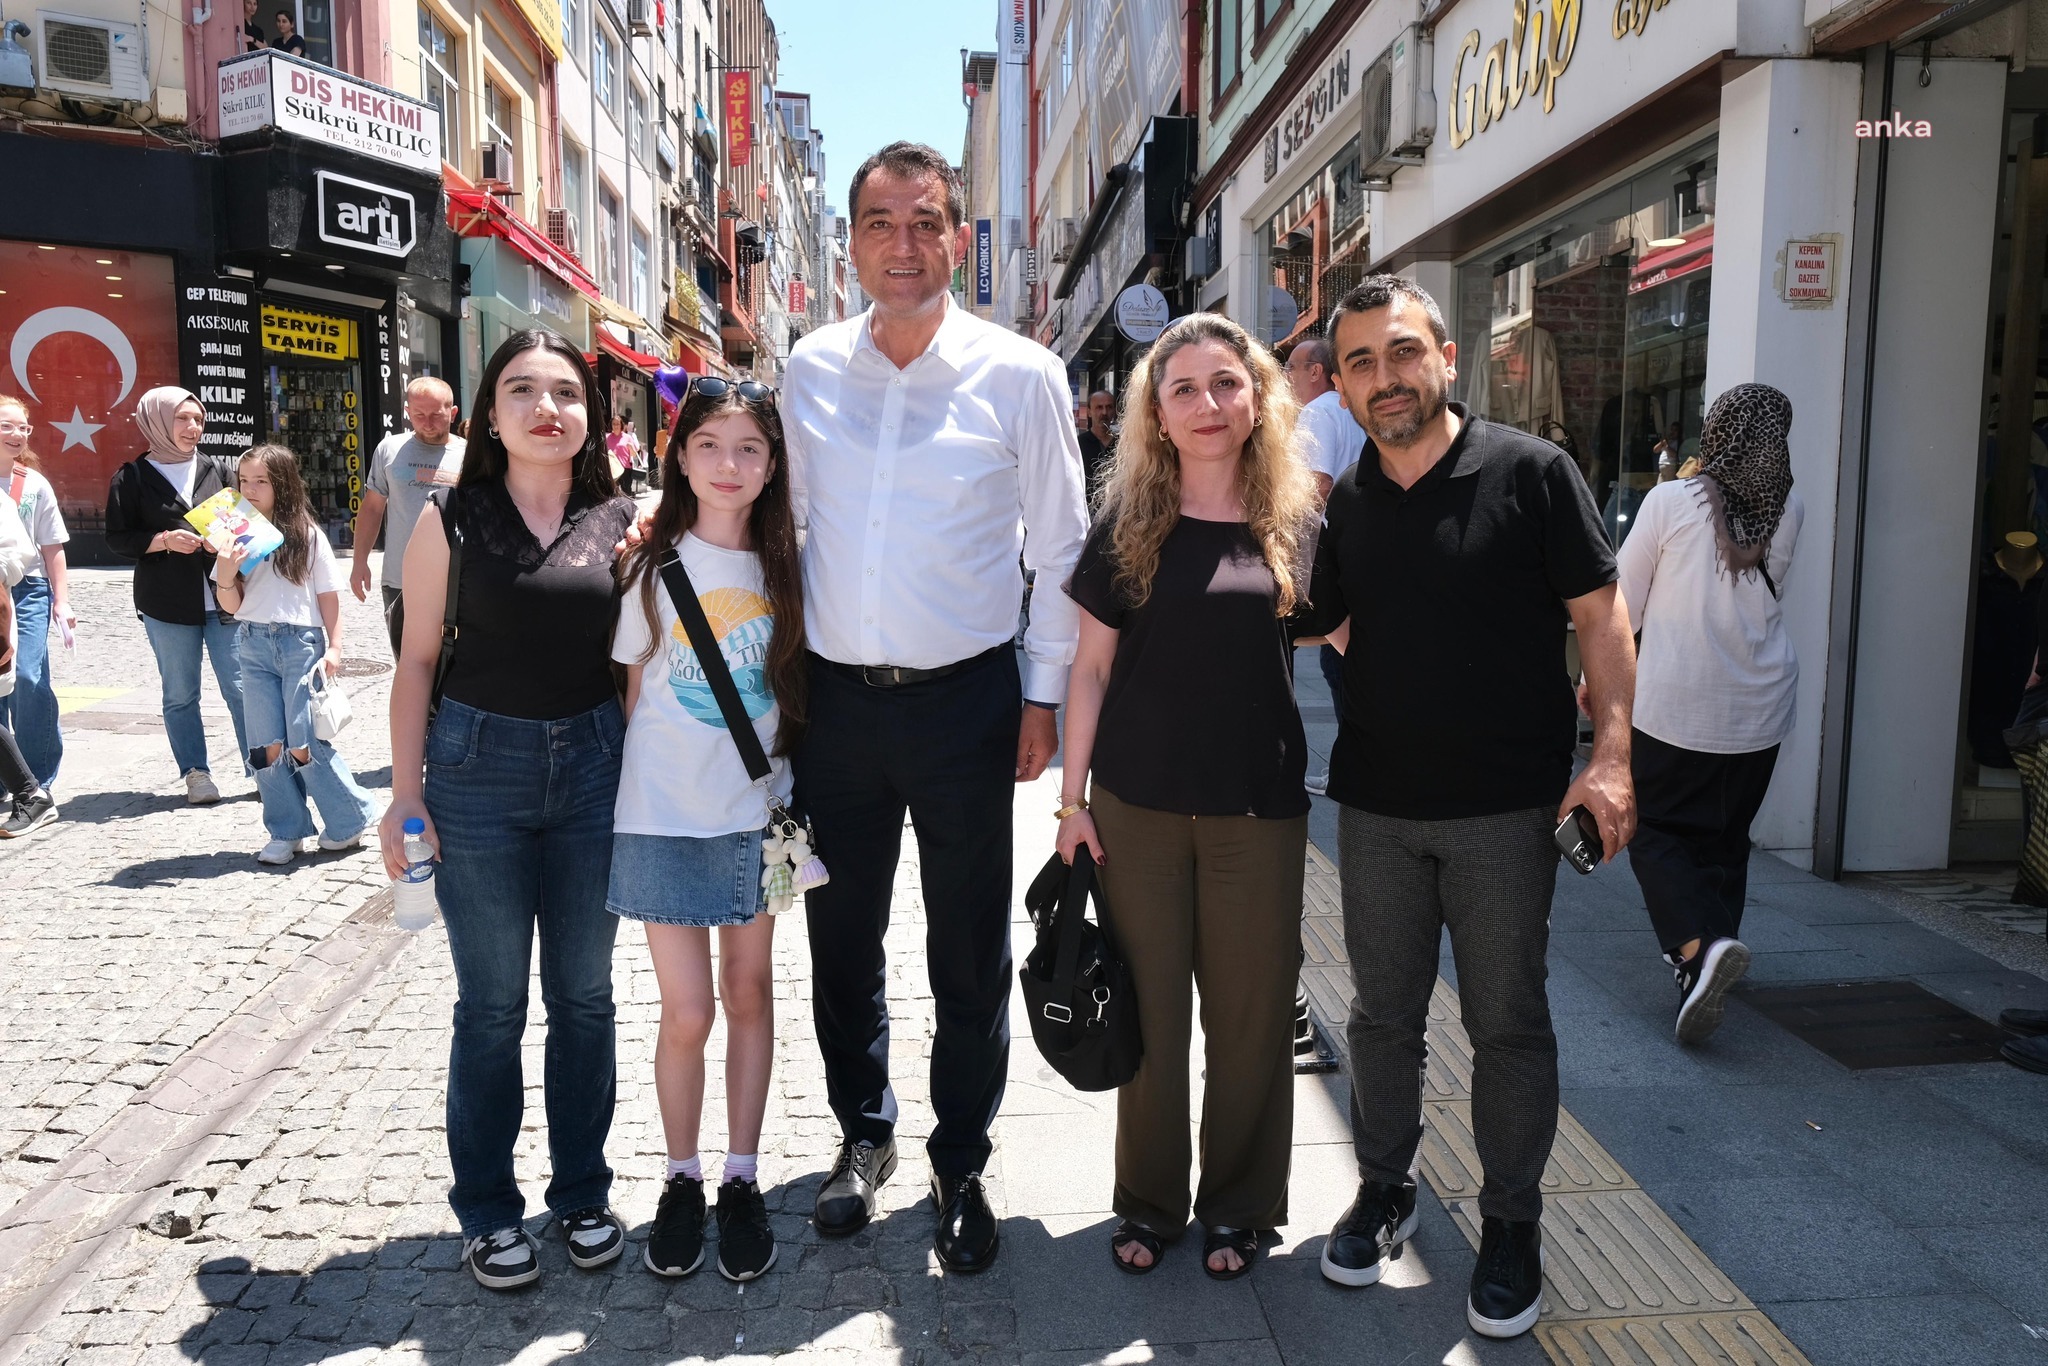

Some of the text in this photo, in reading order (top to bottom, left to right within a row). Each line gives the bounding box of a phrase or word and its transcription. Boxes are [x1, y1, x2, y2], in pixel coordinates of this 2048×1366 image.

[1014, 0, 1024, 44] INAVKURS
[222, 62, 267, 95] DİŞ HEKİMİ
[1448, 0, 1581, 150] Galip
[222, 93, 266, 117] Şükrü KILIÇ
[290, 70, 422, 132] DİŞ HEKİMİ
[285, 95, 432, 158] Şükrü KILIÇ
[730, 100, 745, 146] TKP
[323, 128, 402, 159] TEL. 212 70 60
[1799, 245, 1823, 255] KEPENK
[1794, 259, 1825, 270] KANALINA
[980, 278, 989, 293] LC
[1798, 274, 1820, 283] GAZETE
[186, 287, 247, 306] CEP TELEFONU
[1789, 287, 1827, 298] SOKMAYINIZ
[187, 315, 250, 333] AKSESUAR
[263, 314, 340, 337] SERVİS
[399, 318, 408, 340] 12
[200, 342, 242, 357] ŞARJ ALETİ
[267, 333, 337, 354] TAMİR
[378, 314, 391, 394] KREDİ
[399, 345, 410, 366] AY
[197, 365, 246, 379] POWER BANK
[200, 386, 246, 404] KILIF
[204, 412, 254, 425] RILMAZ CAM
[223, 431, 254, 448] DEĞİŞİMİ
[408, 462, 444, 470] UNIVERSL
